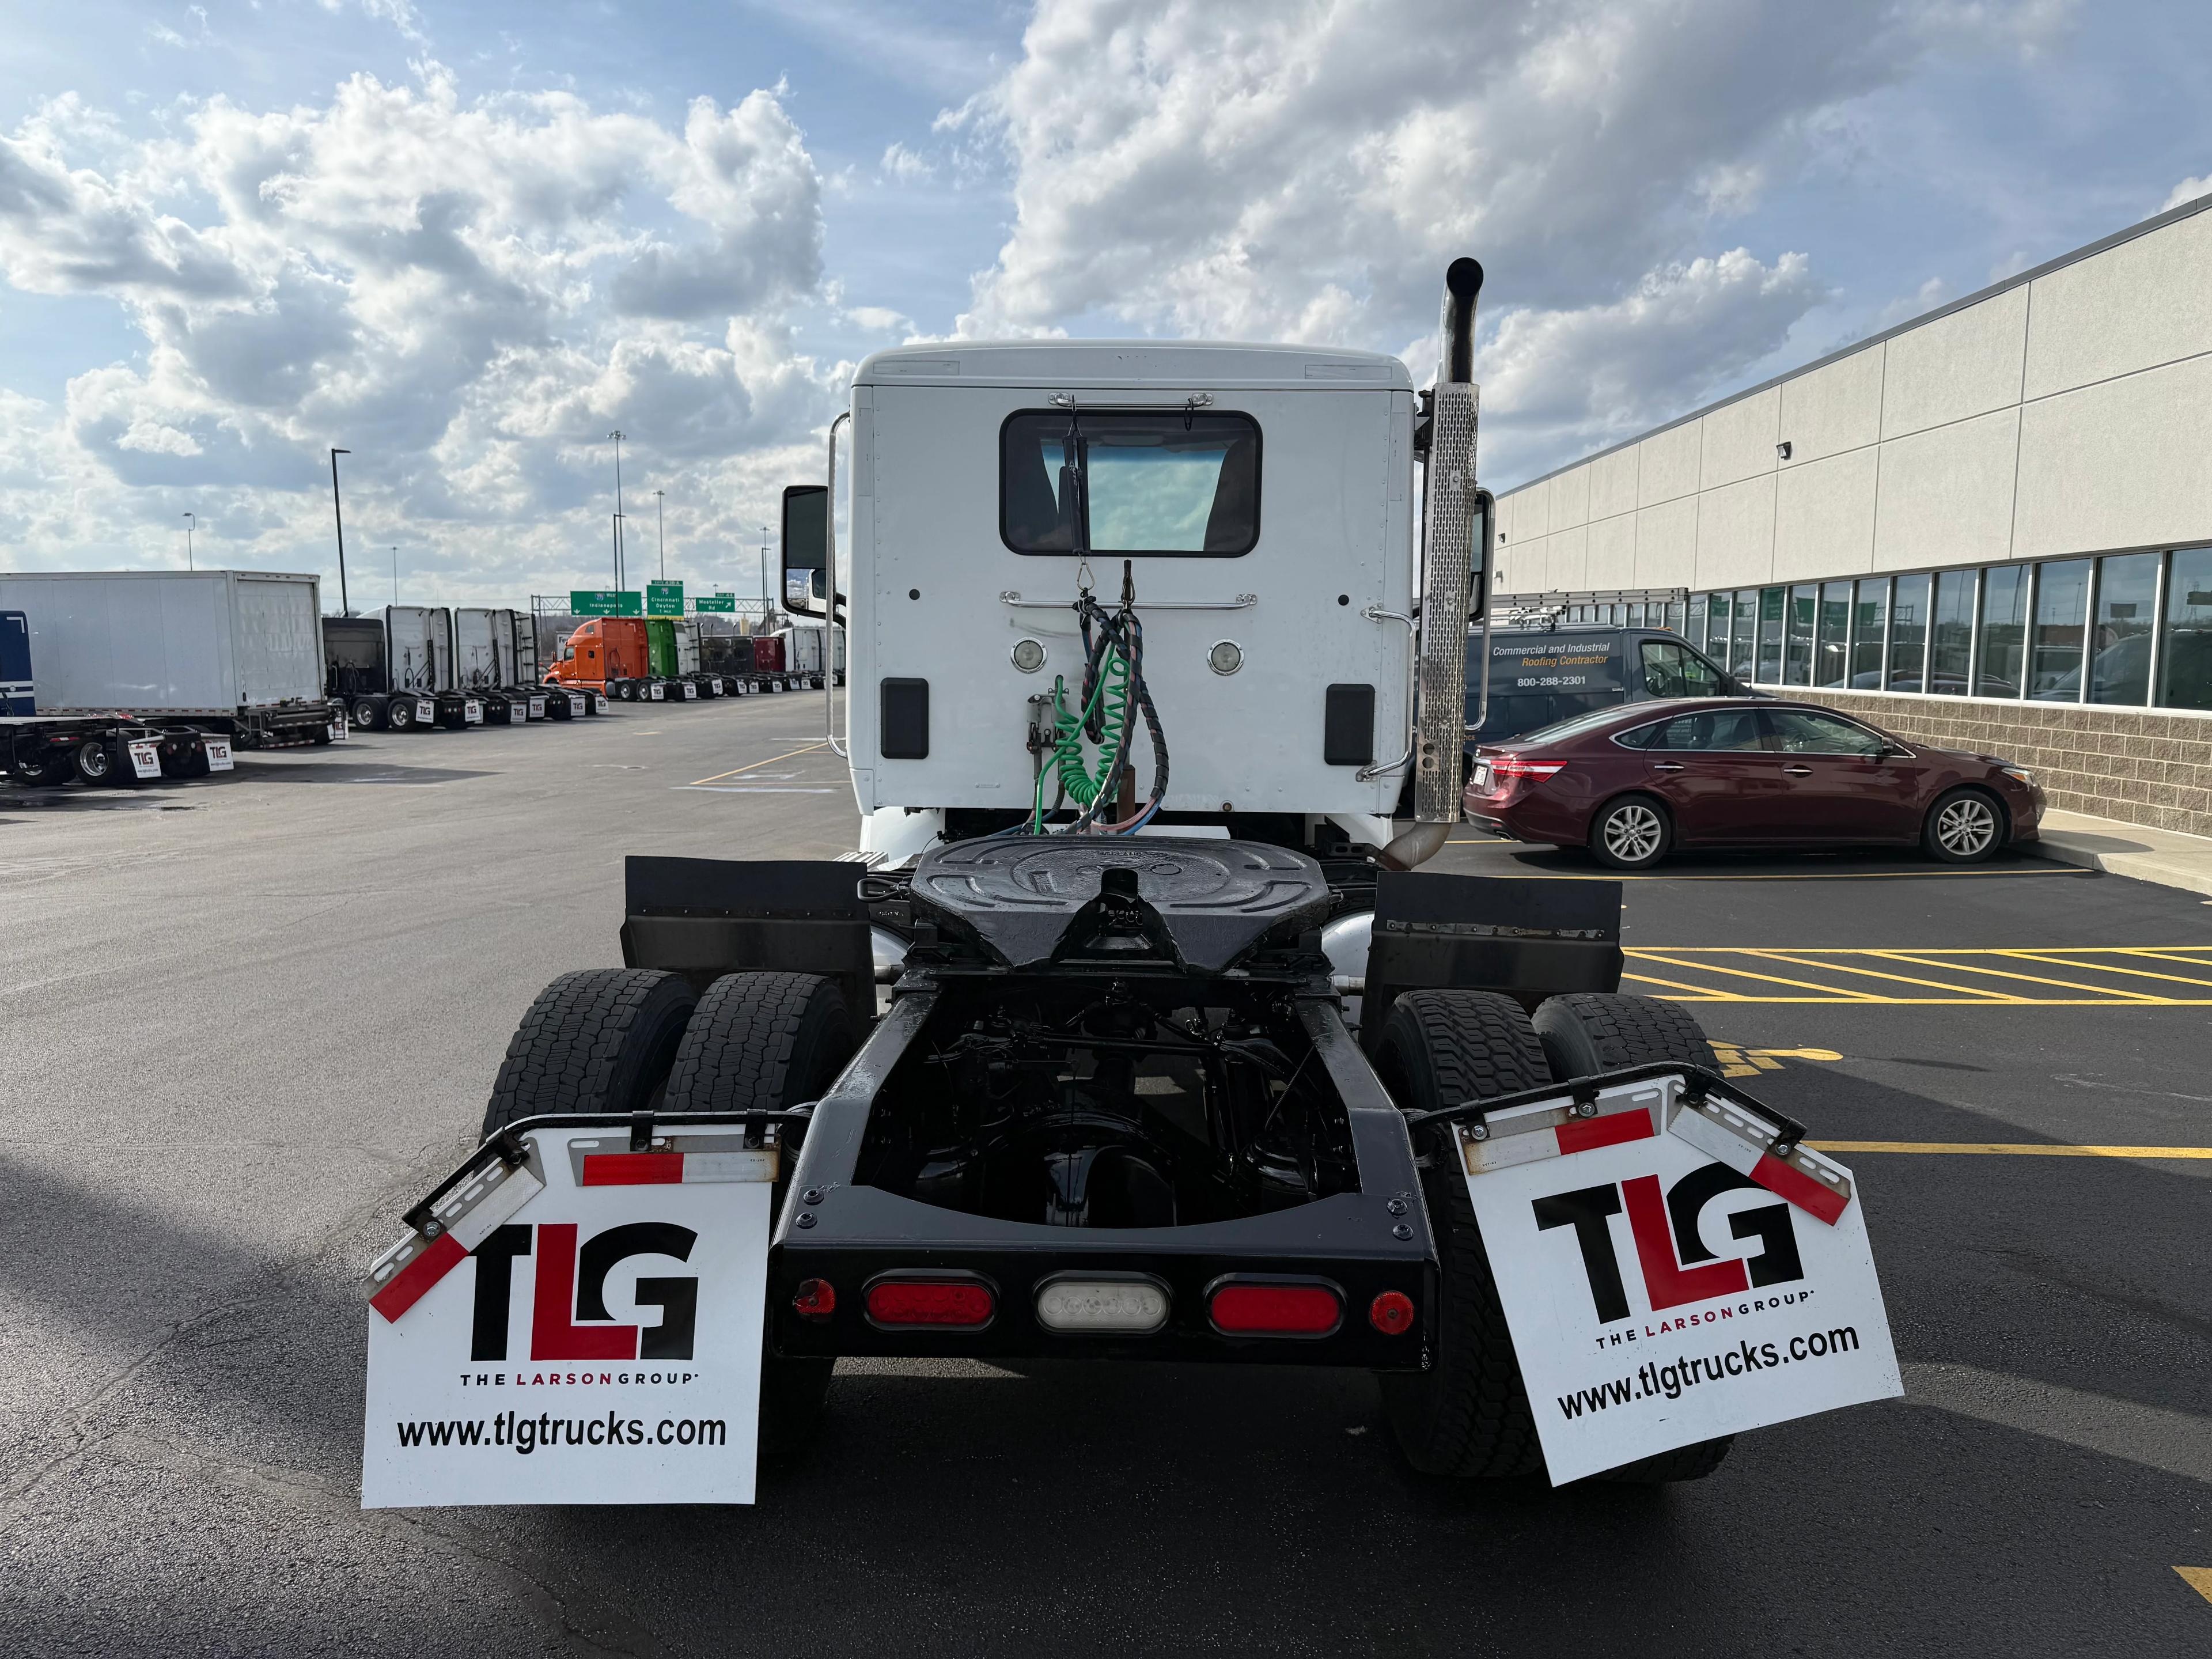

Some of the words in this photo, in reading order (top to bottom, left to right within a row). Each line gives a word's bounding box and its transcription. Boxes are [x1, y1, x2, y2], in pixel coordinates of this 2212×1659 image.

[1493, 645, 1546, 656] Commercial
[1548, 644, 1565, 654] and
[1567, 642, 1610, 653] Industrial
[1522, 657, 1557, 668] Roofing
[1560, 655, 1608, 665] Contractor
[1517, 676, 1586, 687] 800-288-2301
[419, 706, 431, 715] TLG
[467, 706, 477, 714] TLG
[134, 752, 154, 766] TLG
[210, 746, 227, 759] TLG
[1531, 1161, 1804, 1325] TLG
[468, 1222, 699, 1362] TLG
[1595, 1329, 1637, 1350] THE
[460, 1373, 506, 1386] THE
[1557, 1326, 1859, 1421] www.tlgtrucks.com
[397, 1410, 726, 1455] www.tlgtrucks.com
